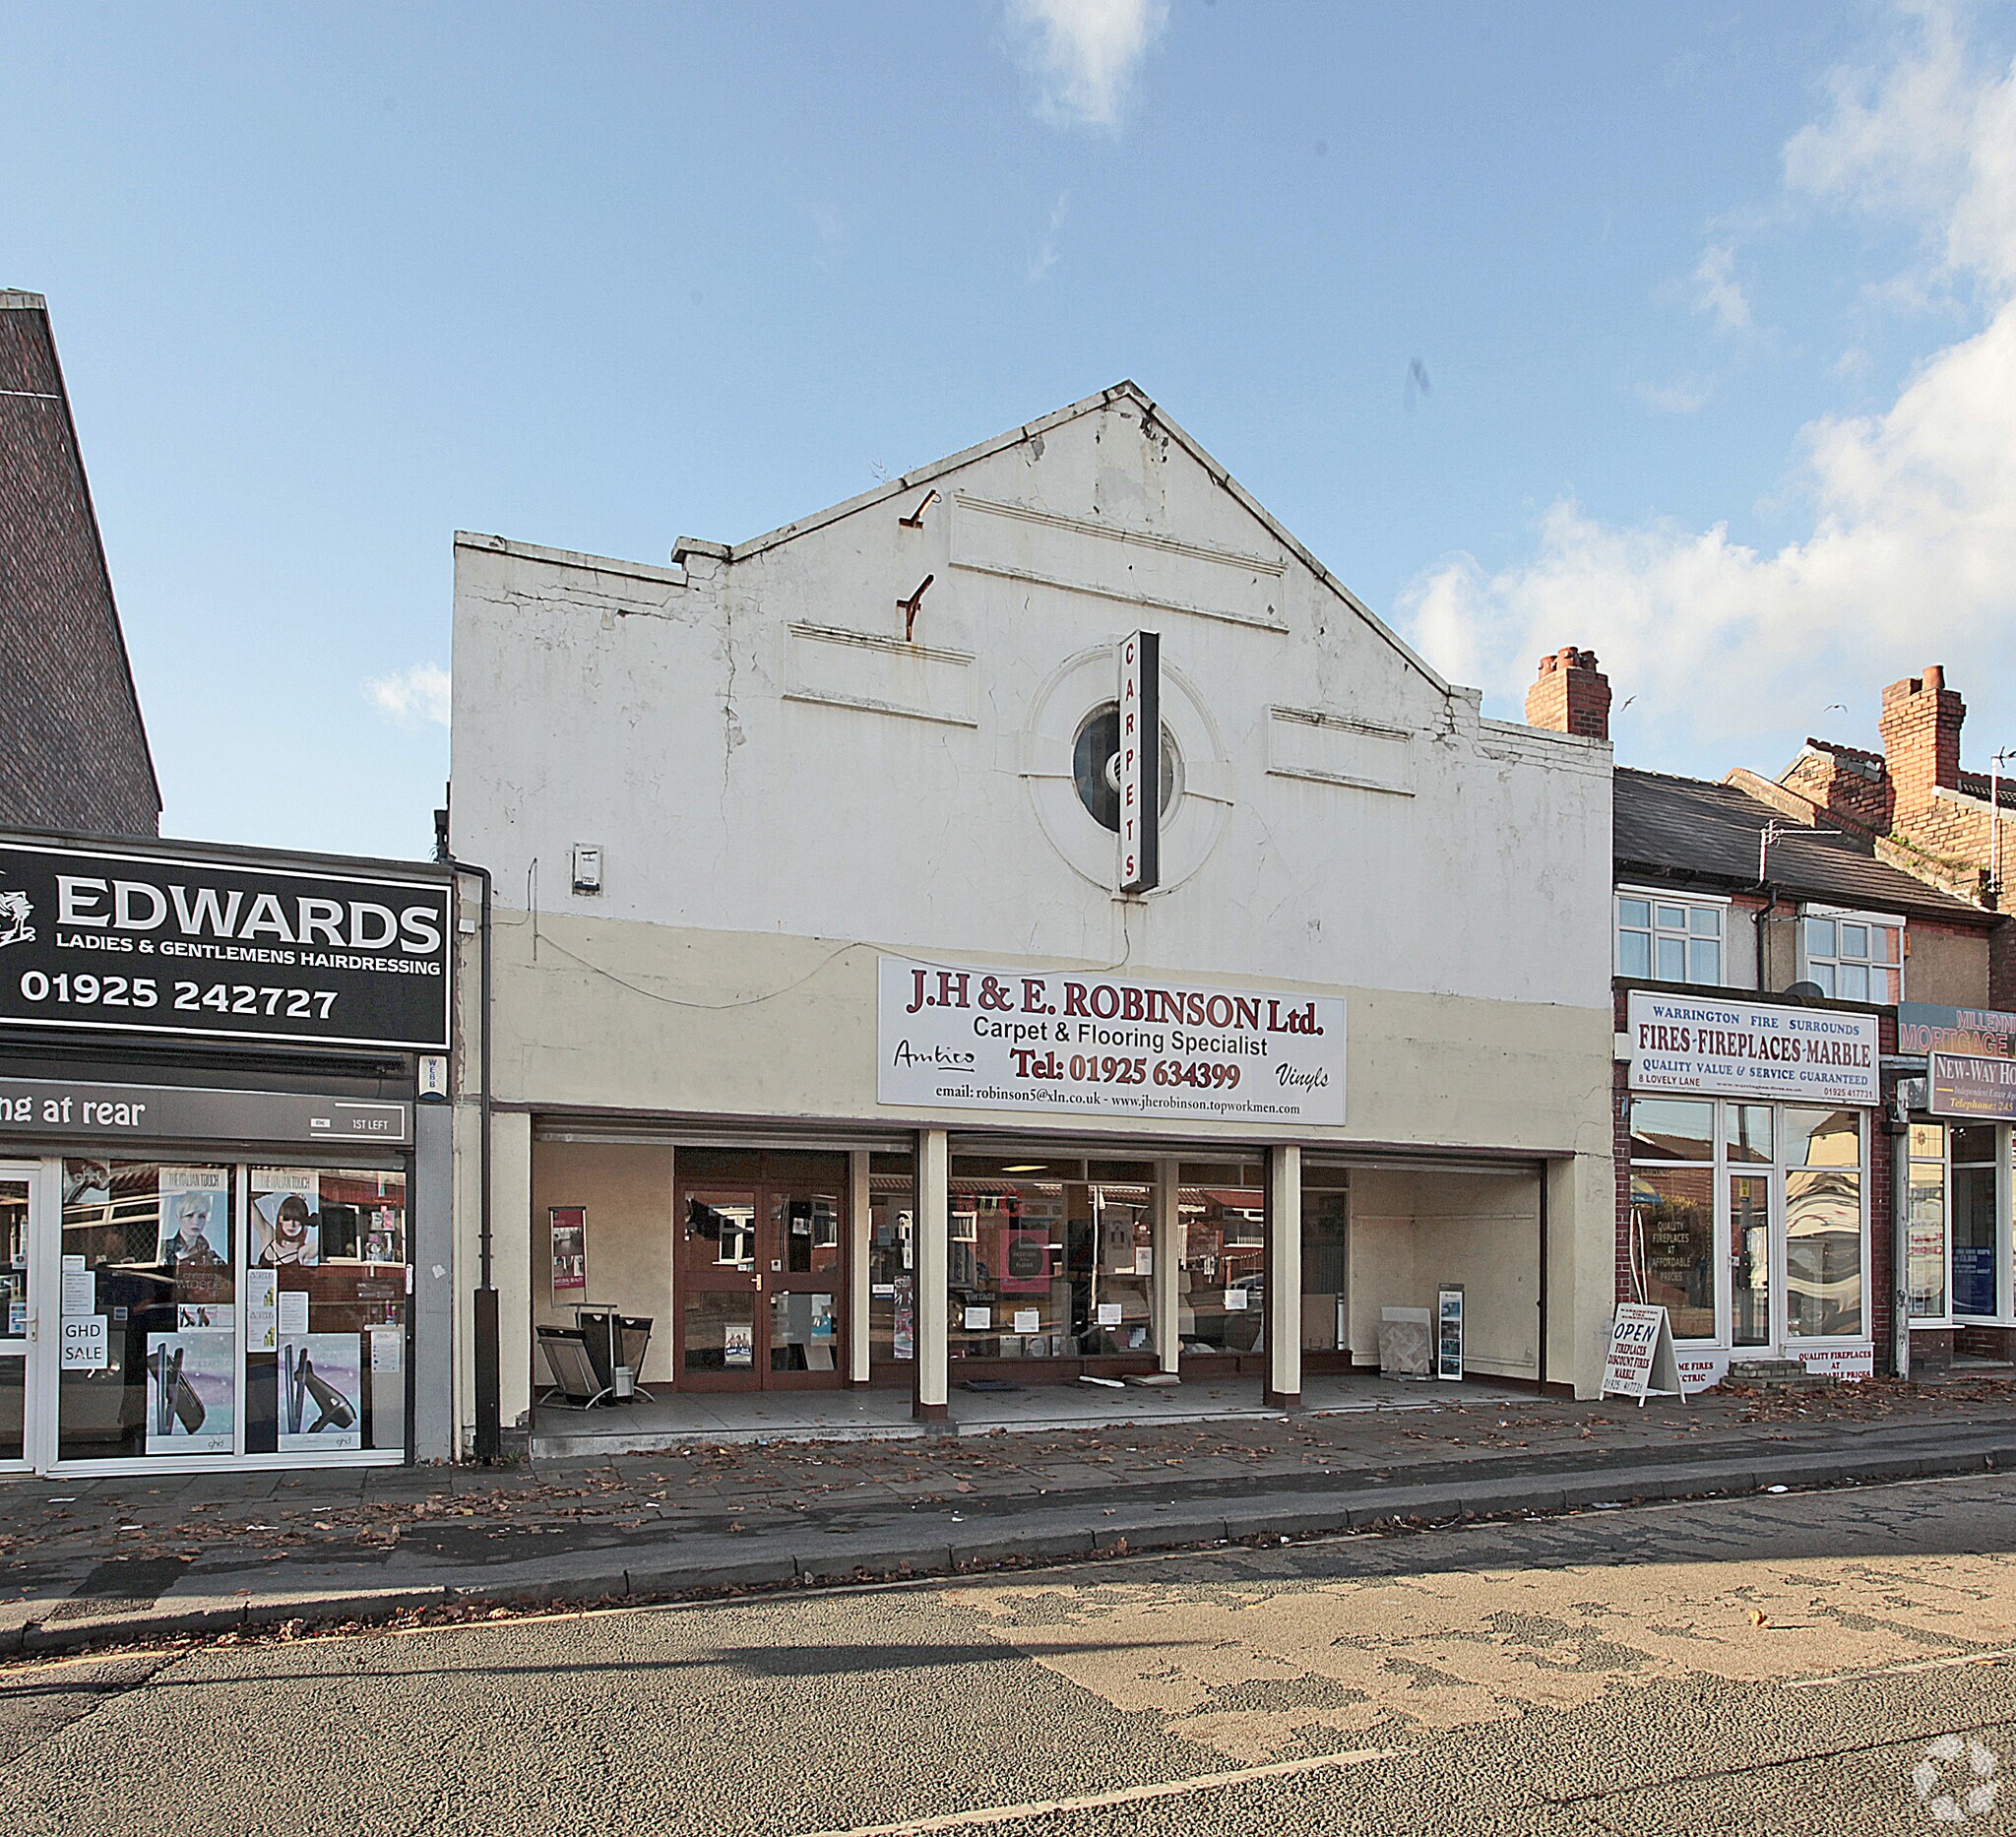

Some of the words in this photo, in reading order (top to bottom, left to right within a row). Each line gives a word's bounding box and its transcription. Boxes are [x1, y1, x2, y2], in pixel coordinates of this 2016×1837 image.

[1125, 642, 1135, 878] CARPETS
[55, 874, 441, 954] EDWARDS
[56, 932, 134, 952] LADIES
[138, 938, 155, 954] &
[159, 940, 295, 965] GENTLEMENS
[300, 951, 441, 976] HAIRDRESSING
[20, 970, 158, 1008] 01925
[174, 982, 339, 1020] 242727
[906, 969, 971, 1014] J.H
[977, 975, 1015, 1012] &
[1021, 979, 1056, 1015] E.
[1063, 982, 1262, 1031] ROBINSON
[1267, 999, 1325, 1037] Ltd.
[1653, 1005, 1740, 1025] WARRINGTON
[1750, 1015, 1779, 1029] FIRE
[1789, 1019, 1860, 1037] SURROUNDS
[973, 1015, 1047, 1044] Carpet
[1054, 1021, 1070, 1042] &
[1078, 1023, 1165, 1053] Flooring
[1171, 1030, 1268, 1056] Specialist
[1900, 1023, 2010, 1058] MORTGAGE
[893, 1039, 976, 1069] Amtico
[427, 1058, 438, 1088] WEBB
[1009, 1047, 1064, 1080] Tel:
[1069, 1053, 1148, 1084] 01925
[1152, 1059, 1241, 1090] 634399
[1642, 1058, 1692, 1073] QUALITY
[1696, 1063, 1733, 1075] VALUE
[1736, 1066, 1745, 1076] &
[1749, 1067, 1796, 1080] SERVICE
[1799, 1071, 1868, 1086] GUARANTEED
[1275, 1062, 1330, 1093] Vinyls
[1638, 1073, 1644, 1083] 8
[1646, 1075, 1677, 1085] LOVELY
[1679, 1077, 1701, 1087] LANE
[1823, 1087, 1846, 1097] 01925
[1847, 1089, 1873, 1099] 417731
[1955, 1085, 1988, 1098] Independent
[935, 1085, 975, 1100] email:
[976, 1087, 1102, 1105] robinson5@xln.co.uk
[1110, 1095, 1301, 1115] www.jherobinson.topworkmen.com
[1949, 1097, 1996, 1111] Telephone:
[1998, 1102, 2014, 1111] 245
[42, 1096, 73, 1123] at
[83, 1101, 146, 1126] rear
[352, 1119, 366, 1129] 1ST
[368, 1120, 389, 1130] LEFT
[1657, 1221, 1684, 1232] QUALITY
[1652, 1233, 1690, 1243] FIREPLACES
[1667, 1245, 1675, 1254] AT
[1652, 1257, 1691, 1268] AFFORDABLE
[1659, 1271, 1683, 1282] PRICES
[65, 1324, 101, 1338] GHD
[1614, 1322, 1657, 1343] OPEN
[65, 1346, 102, 1361] SALE
[1615, 1342, 1647, 1357] FIREPLACES
[1798, 1352, 1829, 1362] QUALITY
[1830, 1350, 1872, 1360] FIREPLACES
[1606, 1354, 1634, 1367] DISCOUNT
[1633, 1357, 1651, 1369] FIRES
[1691, 1362, 1714, 1370] FIRES
[1613, 1367, 1636, 1380] MARBLE
[1604, 1378, 1621, 1390] 01925
